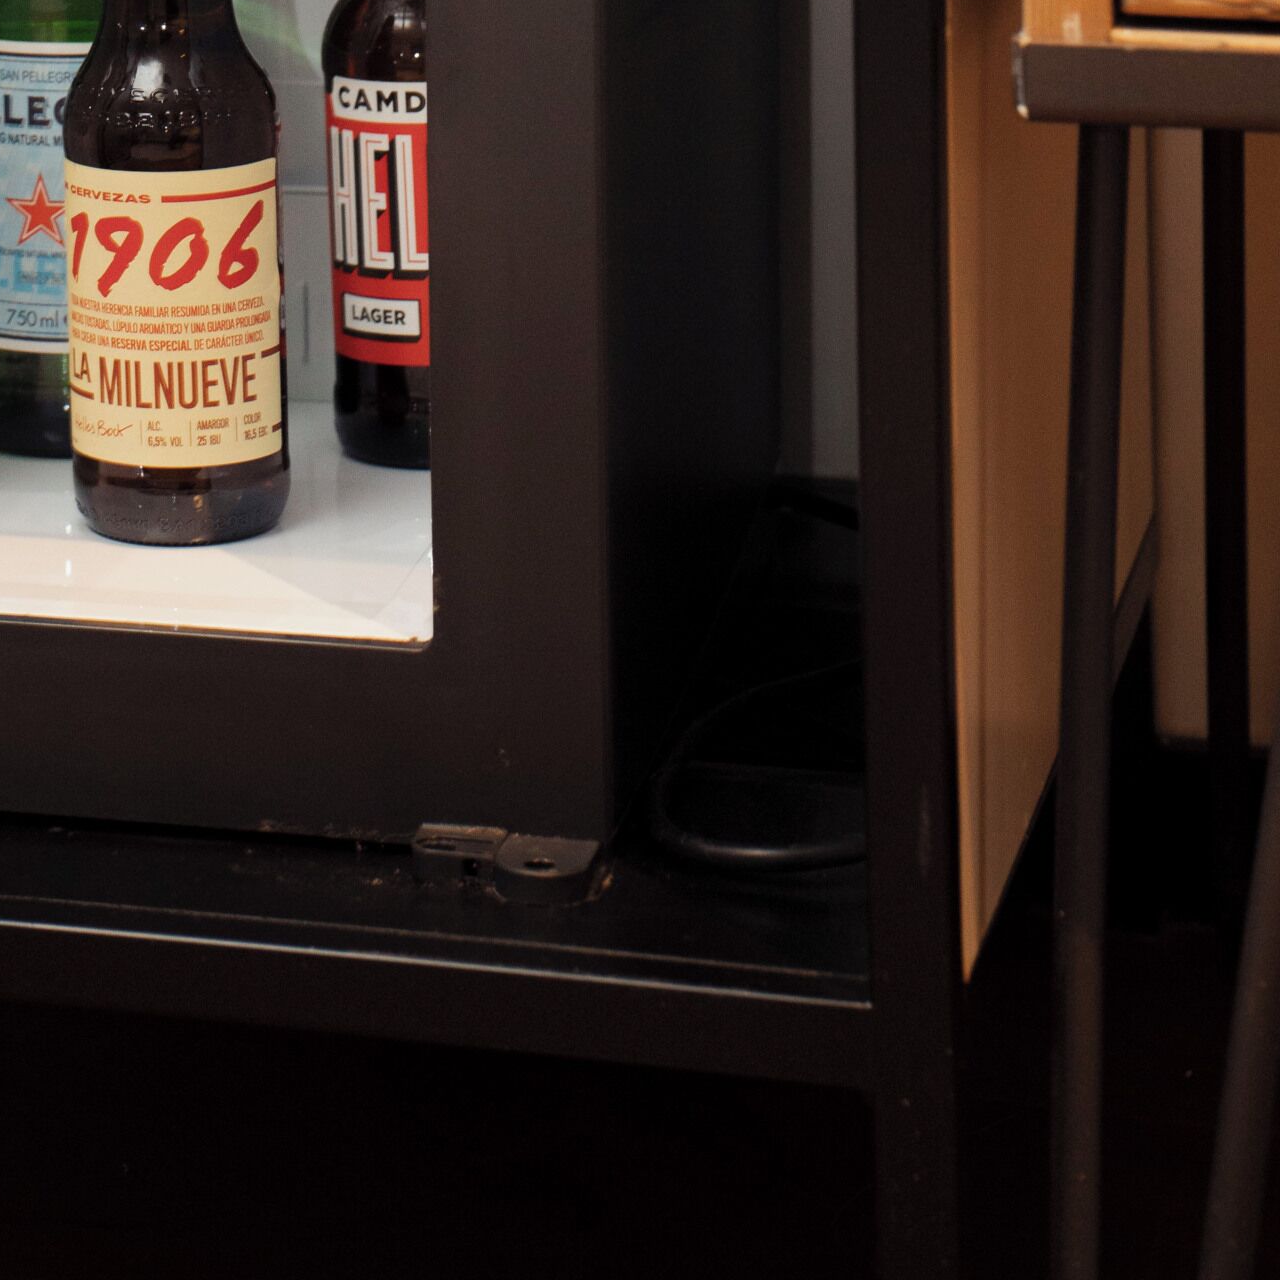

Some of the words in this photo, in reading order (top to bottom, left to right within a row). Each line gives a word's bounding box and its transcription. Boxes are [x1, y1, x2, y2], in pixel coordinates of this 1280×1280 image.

[0, 68, 19, 81] SAN
[338, 85, 427, 114] CAMD
[70, 185, 151, 205] CERVEZAS
[330, 125, 429, 272] HEL
[70, 198, 265, 298] 1906
[6, 308, 37, 326] 750
[40, 310, 60, 328] ml
[134, 305, 169, 318] FAMILIAR
[171, 305, 210, 318] RESUMIDA
[211, 303, 221, 315] EN
[222, 301, 237, 314] UNA
[351, 304, 406, 326] LAGER
[190, 322, 206, 334] UNA
[207, 320, 235, 333] GUARDA
[111, 336, 147, 351] RESERVA
[149, 339, 192, 352] ESPECIAL
[194, 339, 205, 351] DE
[72, 347, 91, 384] LA
[98, 351, 258, 410] MILNUEVE
[197, 435, 207, 447] 25
